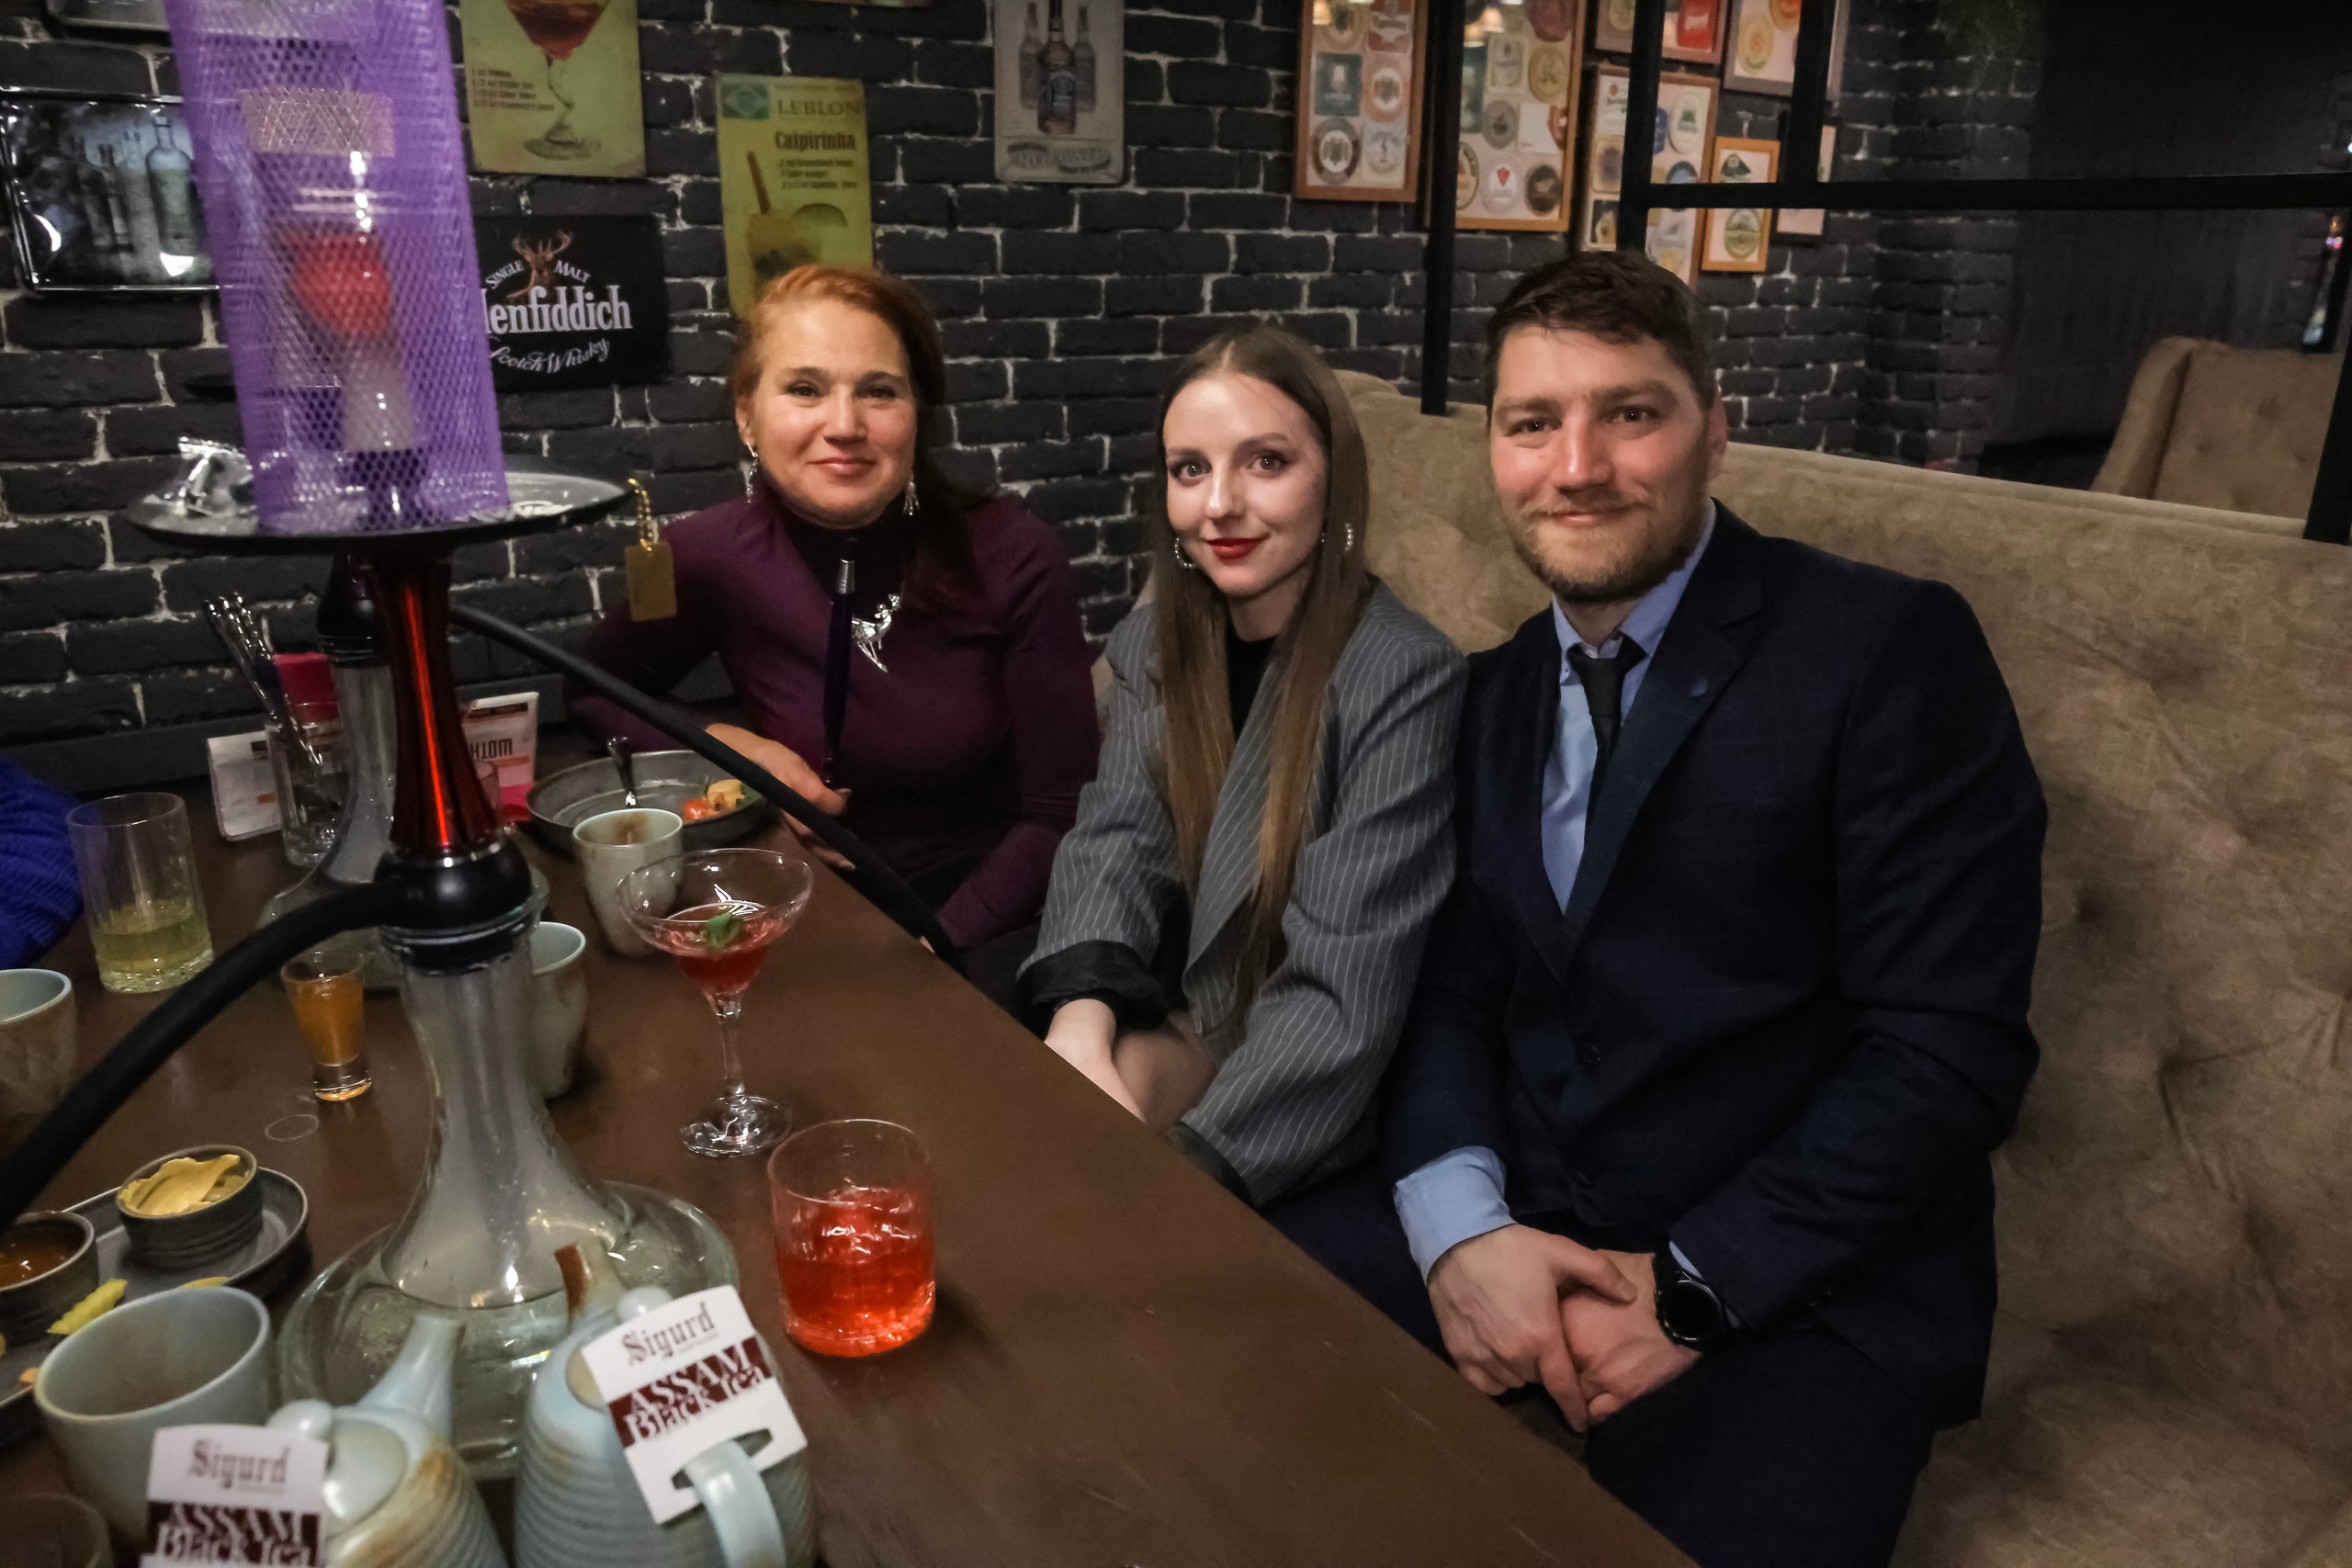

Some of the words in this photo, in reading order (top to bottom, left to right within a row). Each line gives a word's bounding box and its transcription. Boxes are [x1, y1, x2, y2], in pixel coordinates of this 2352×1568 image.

[777, 99, 862, 116] LEBLON
[775, 130, 856, 152] Caipirinha
[484, 260, 526, 289] SINGLE
[554, 259, 592, 283] MALT
[481, 285, 633, 334] lenfiddich
[547, 338, 610, 374] Whisky
[621, 1301, 715, 1365] Sigurd
[630, 1342, 752, 1413] ASSAM
[623, 1384, 715, 1443] Black
[187, 1439, 290, 1489] Sigurd
[167, 1503, 303, 1541] ASSAM
